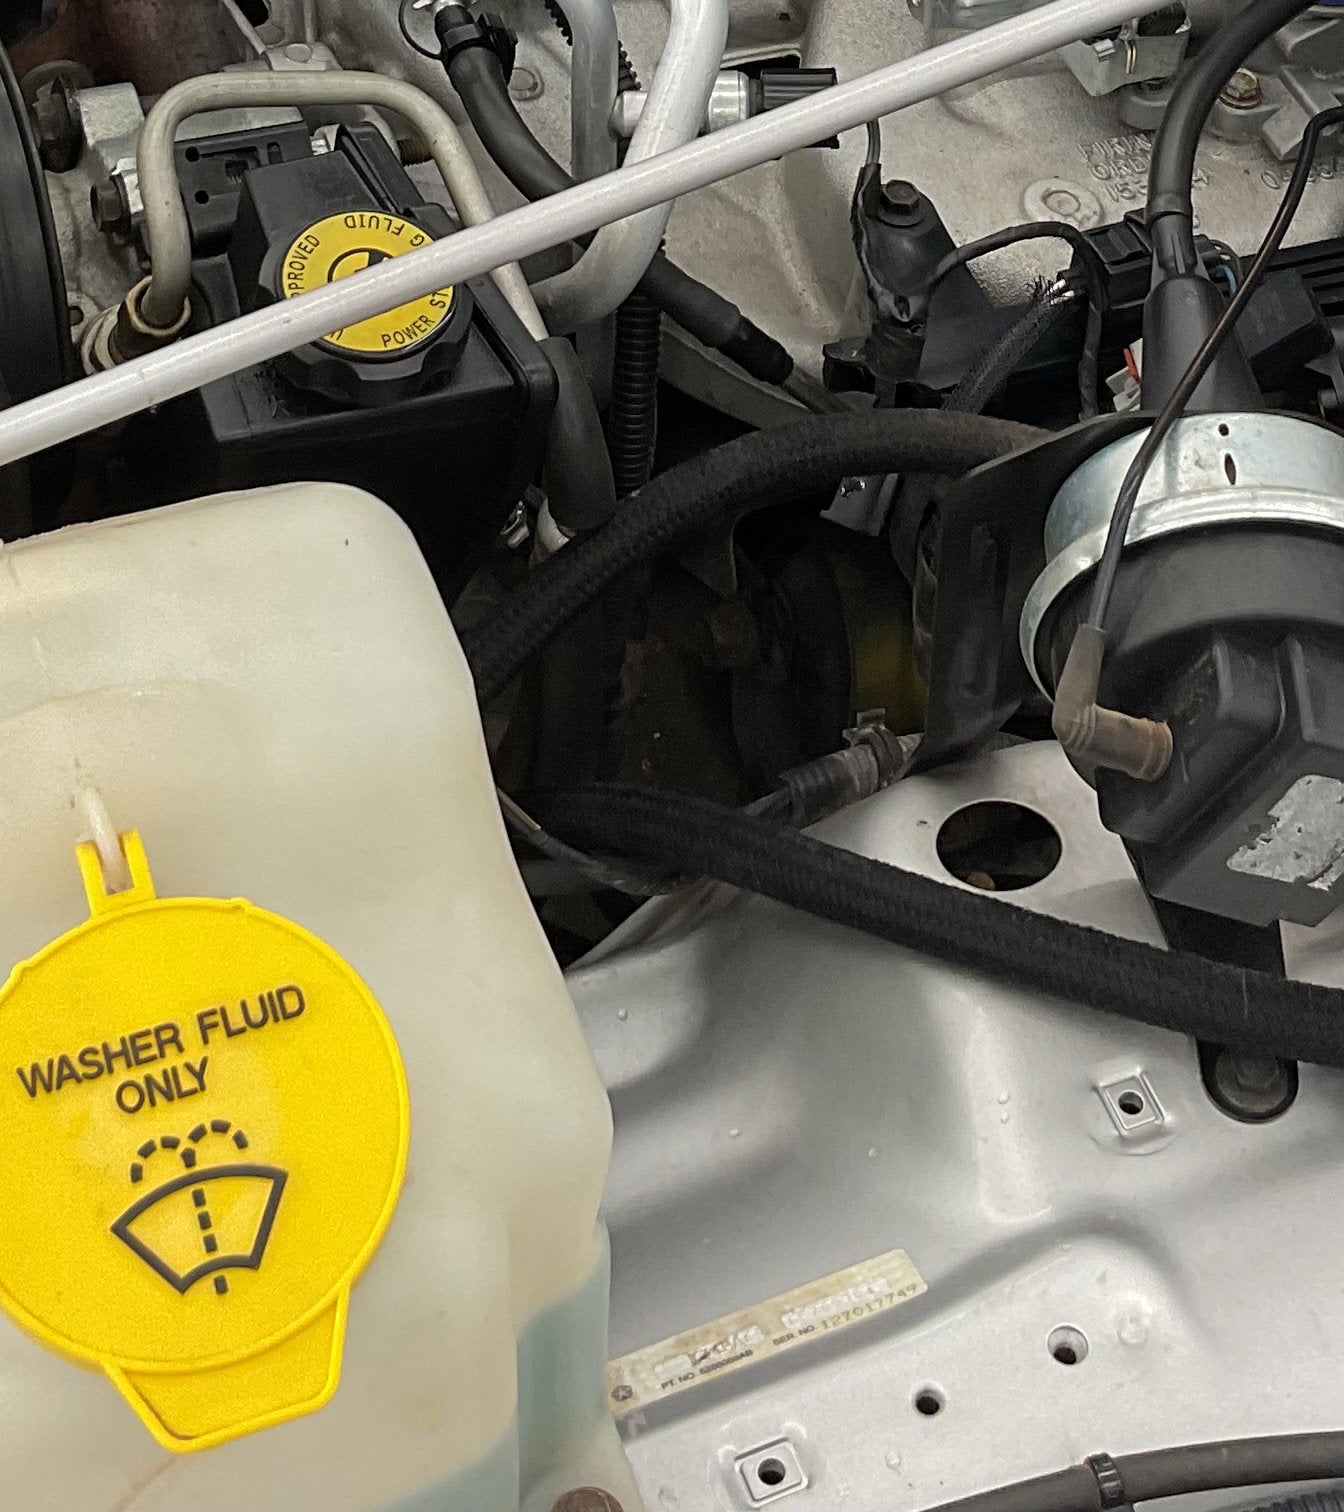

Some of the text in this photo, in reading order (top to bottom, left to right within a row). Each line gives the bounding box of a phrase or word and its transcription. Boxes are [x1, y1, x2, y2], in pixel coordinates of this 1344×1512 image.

[344, 215, 405, 236] FLUID
[381, 314, 436, 348] POWER
[16, 984, 306, 1098] WASHER FLUID
[115, 1055, 209, 1114] ONLY
